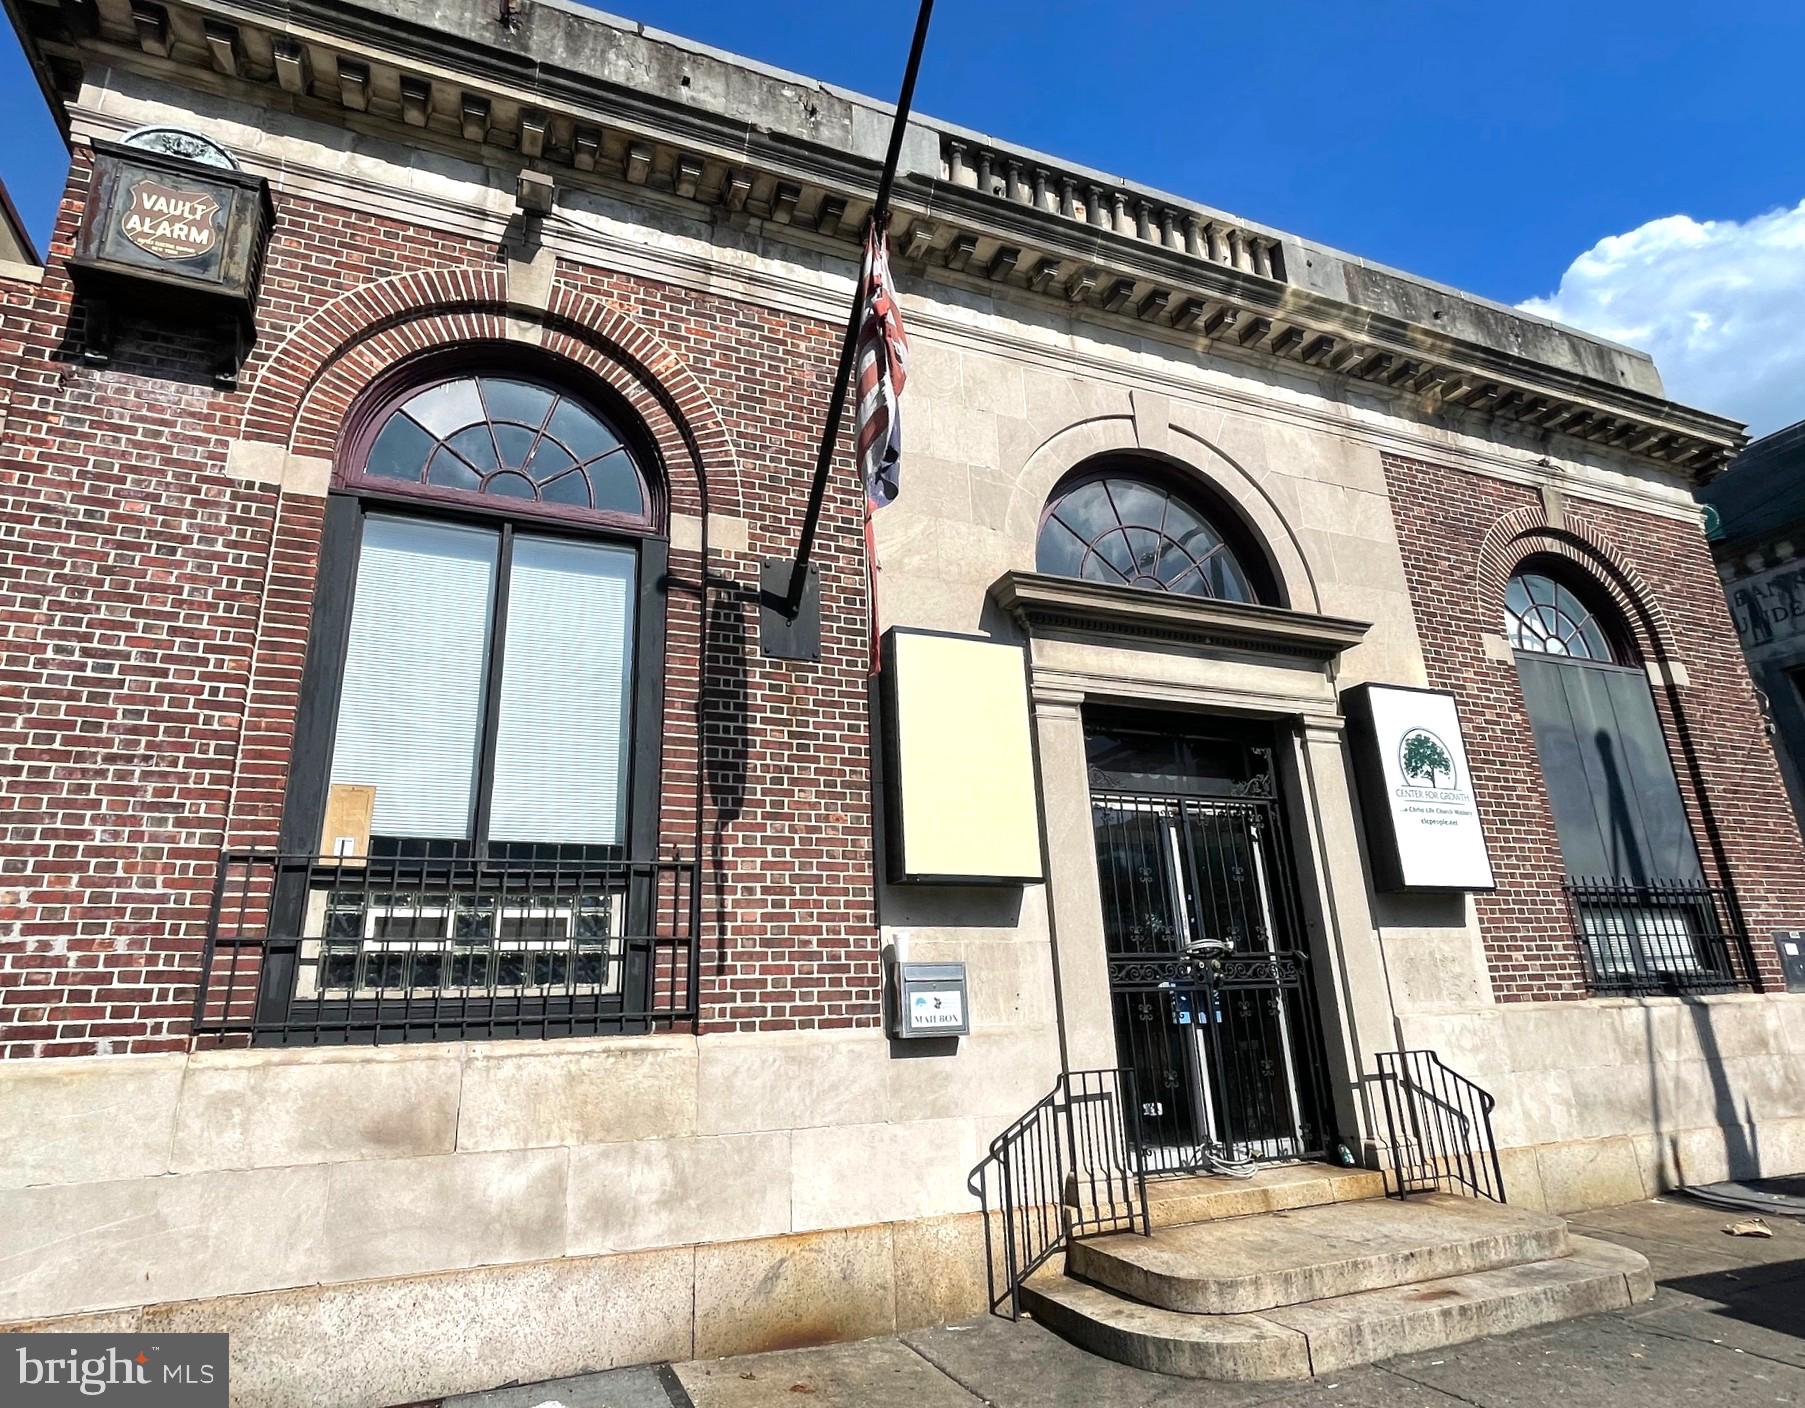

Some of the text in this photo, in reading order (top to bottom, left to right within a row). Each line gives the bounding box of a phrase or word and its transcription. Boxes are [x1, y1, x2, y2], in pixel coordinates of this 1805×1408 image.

[142, 192, 206, 221] VAULT
[126, 214, 209, 245] ALARM
[1395, 788, 1470, 802] CENTER FOR GROWTH
